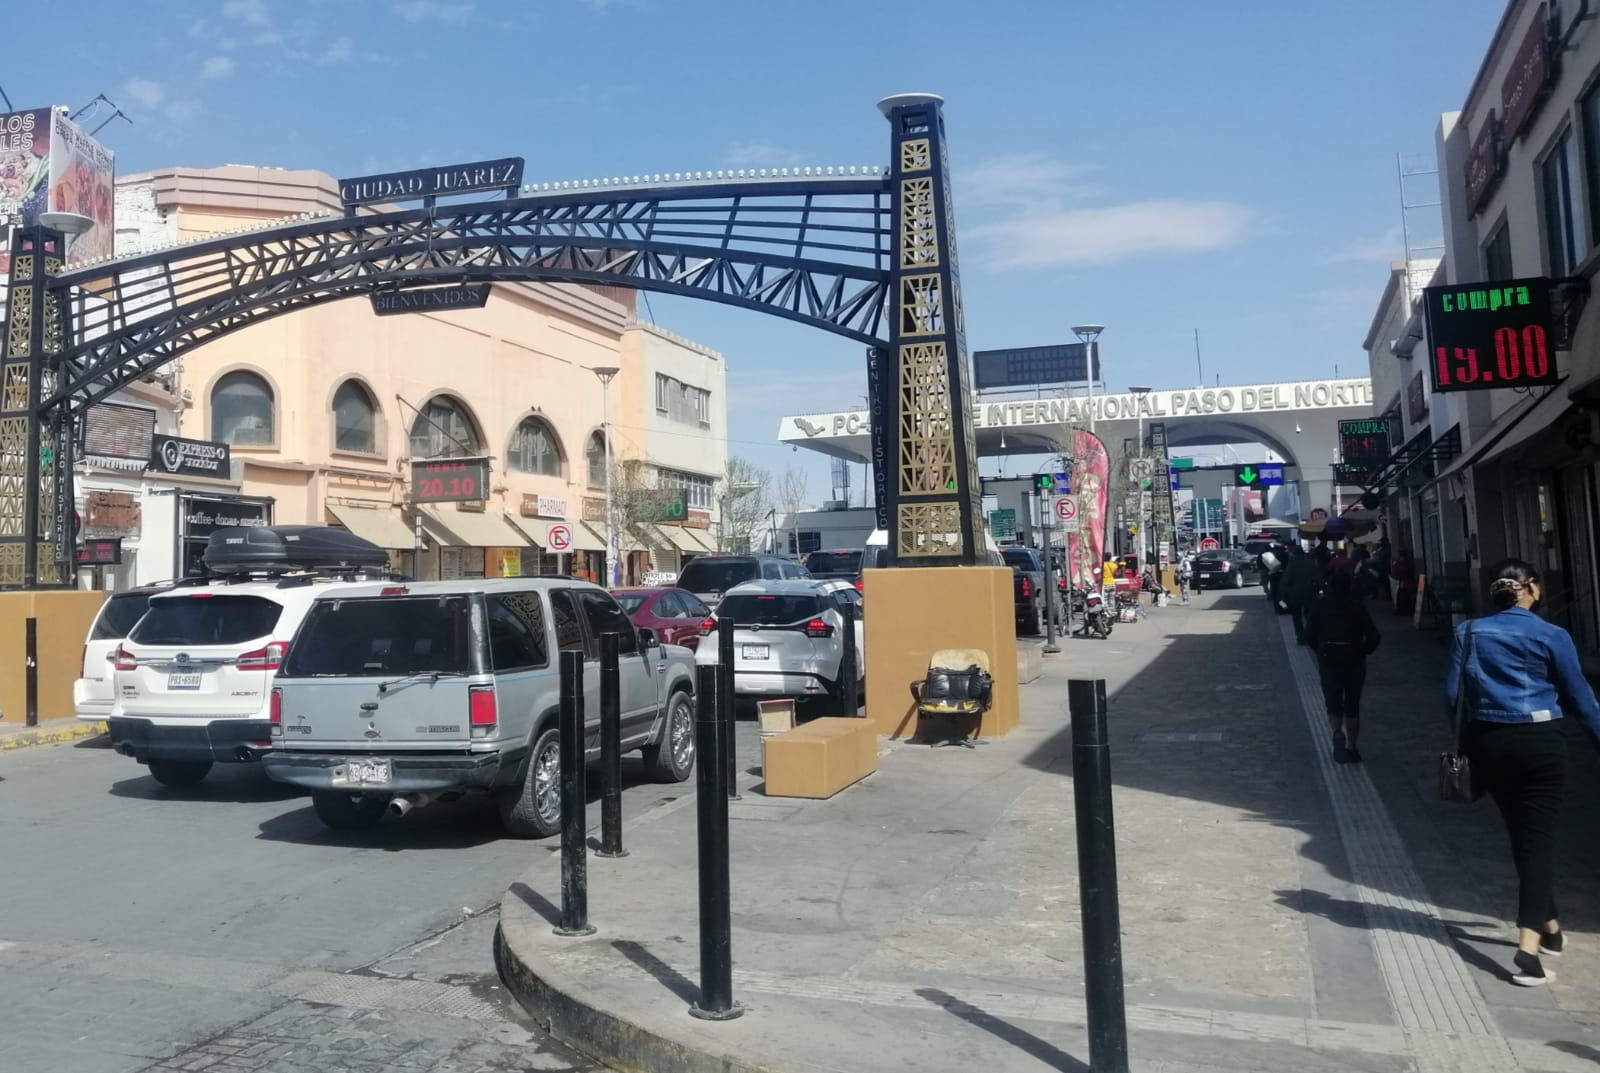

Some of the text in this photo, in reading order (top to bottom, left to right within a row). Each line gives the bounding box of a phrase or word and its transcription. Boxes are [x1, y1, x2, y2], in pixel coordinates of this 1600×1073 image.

[341, 177, 423, 200] CIUDAD
[376, 289, 479, 309] BIENVENIDOS
[987, 394, 1167, 426] INTERNACIONAL
[1171, 389, 1235, 415] PASO
[1241, 386, 1289, 411] DEL
[1342, 420, 1388, 435] COMPRA
[425, 463, 468, 473] VENTA
[419, 477, 475, 498] 20.10
